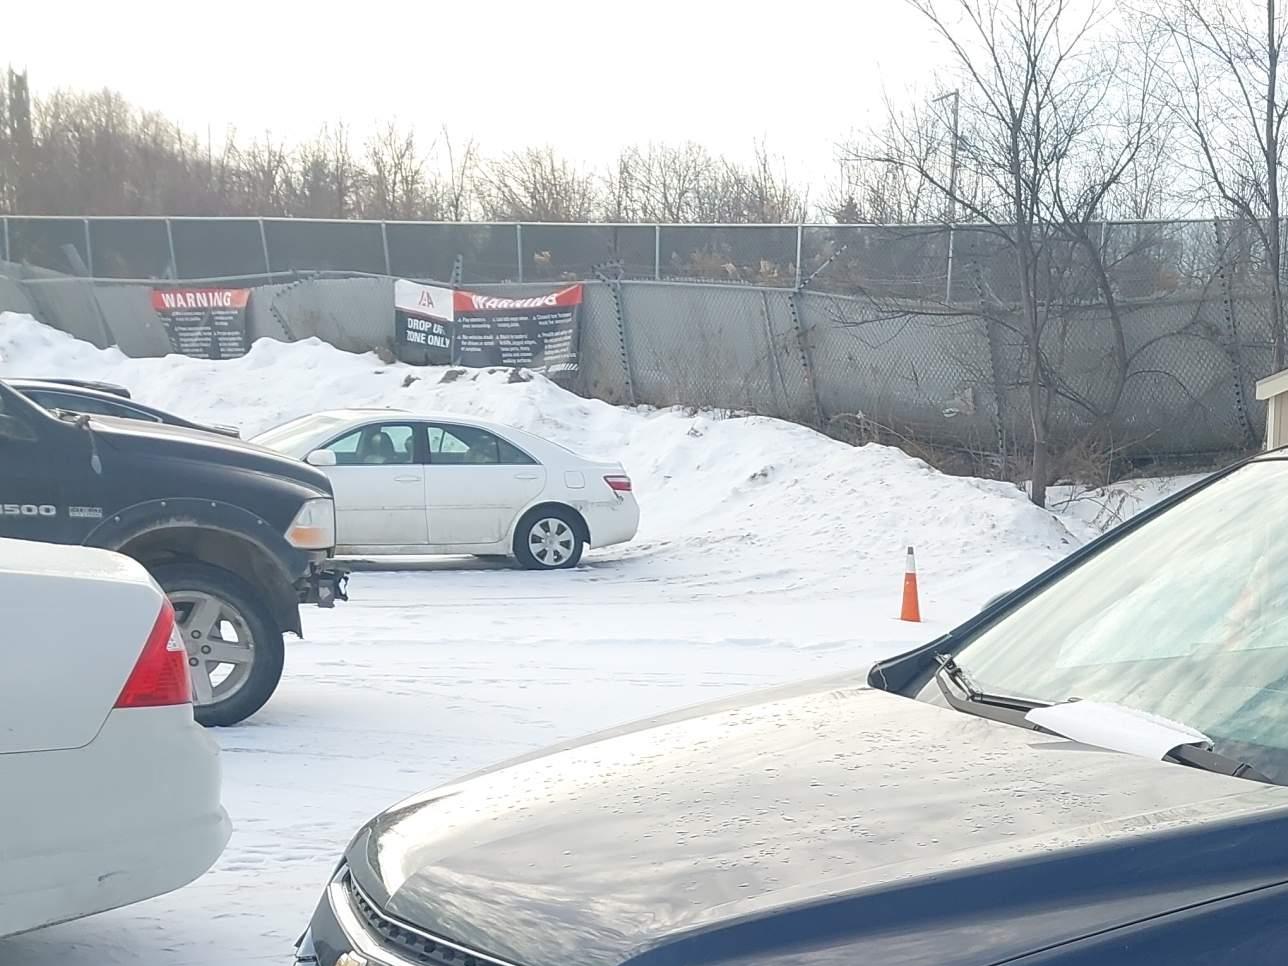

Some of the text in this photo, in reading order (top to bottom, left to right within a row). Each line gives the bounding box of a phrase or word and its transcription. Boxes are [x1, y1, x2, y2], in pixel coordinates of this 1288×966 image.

[161, 291, 232, 308] WARNING
[407, 317, 432, 331] DROP
[427, 334, 450, 348] ONLY
